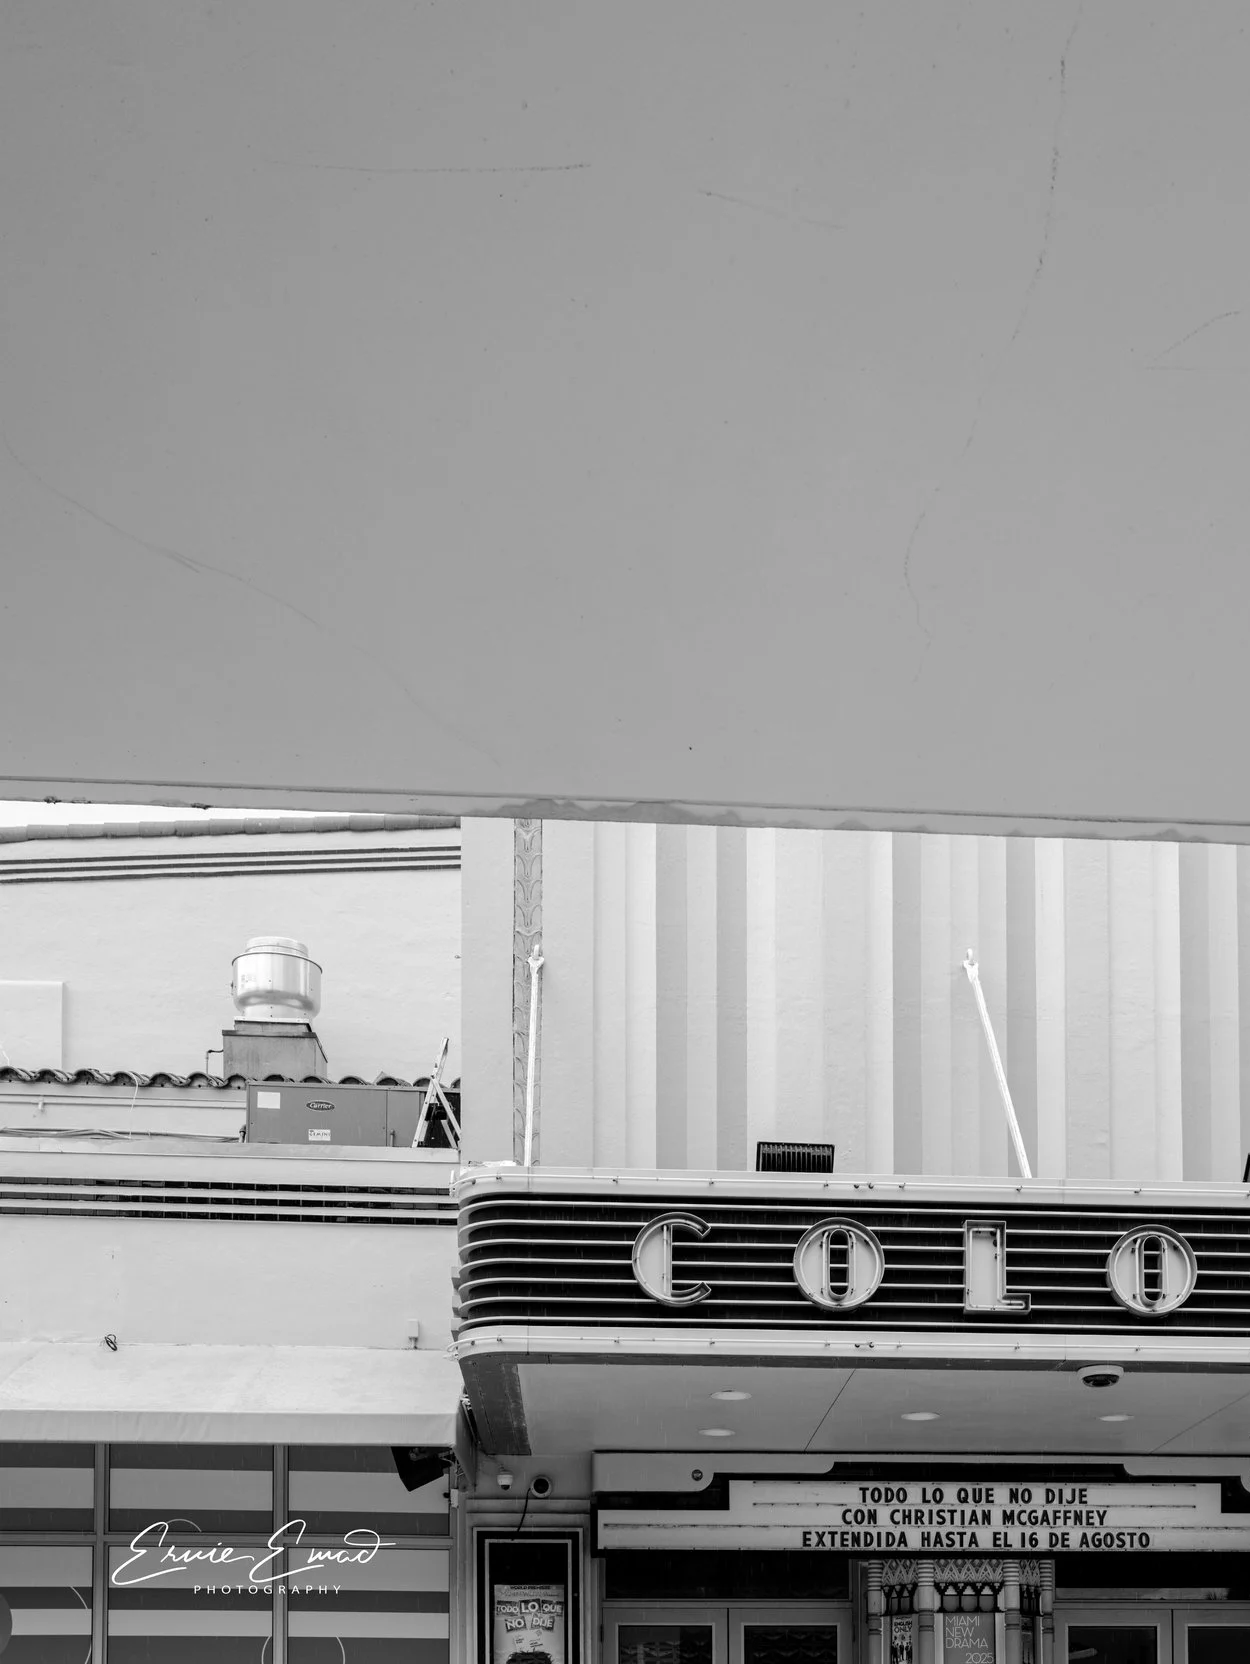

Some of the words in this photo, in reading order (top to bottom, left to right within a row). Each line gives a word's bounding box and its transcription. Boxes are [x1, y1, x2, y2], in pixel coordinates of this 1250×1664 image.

[859, 1487, 907, 1503] TODO
[922, 1487, 944, 1504] LO
[957, 1487, 995, 1504] QUE
[1009, 1487, 1032, 1504] NO
[1046, 1488, 1088, 1505] DIJE
[842, 1509, 877, 1525] CON
[890, 1509, 991, 1525] CHRISTIAN
[1002, 1509, 1107, 1526] MCGAFFNEY
[803, 1531, 908, 1548] EXTENDIDA
[921, 1531, 979, 1548] HASTA
[992, 1532, 1013, 1548] EL
[1020, 1532, 1039, 1548] 16
[1049, 1532, 1070, 1548] DE
[1079, 1532, 1150, 1549] AGOSTO
[496, 1604, 519, 1613] TODO
[521, 1601, 539, 1613] LO
[543, 1604, 562, 1613] QUE
[506, 1618, 525, 1630] NO
[945, 1615, 980, 1626] MIAMI
[893, 1625, 912, 1633] ONLY
[945, 1626, 974, 1638] NEW
[945, 1637, 988, 1649] DRAMA
[965, 1652, 994, 1664] 2025
